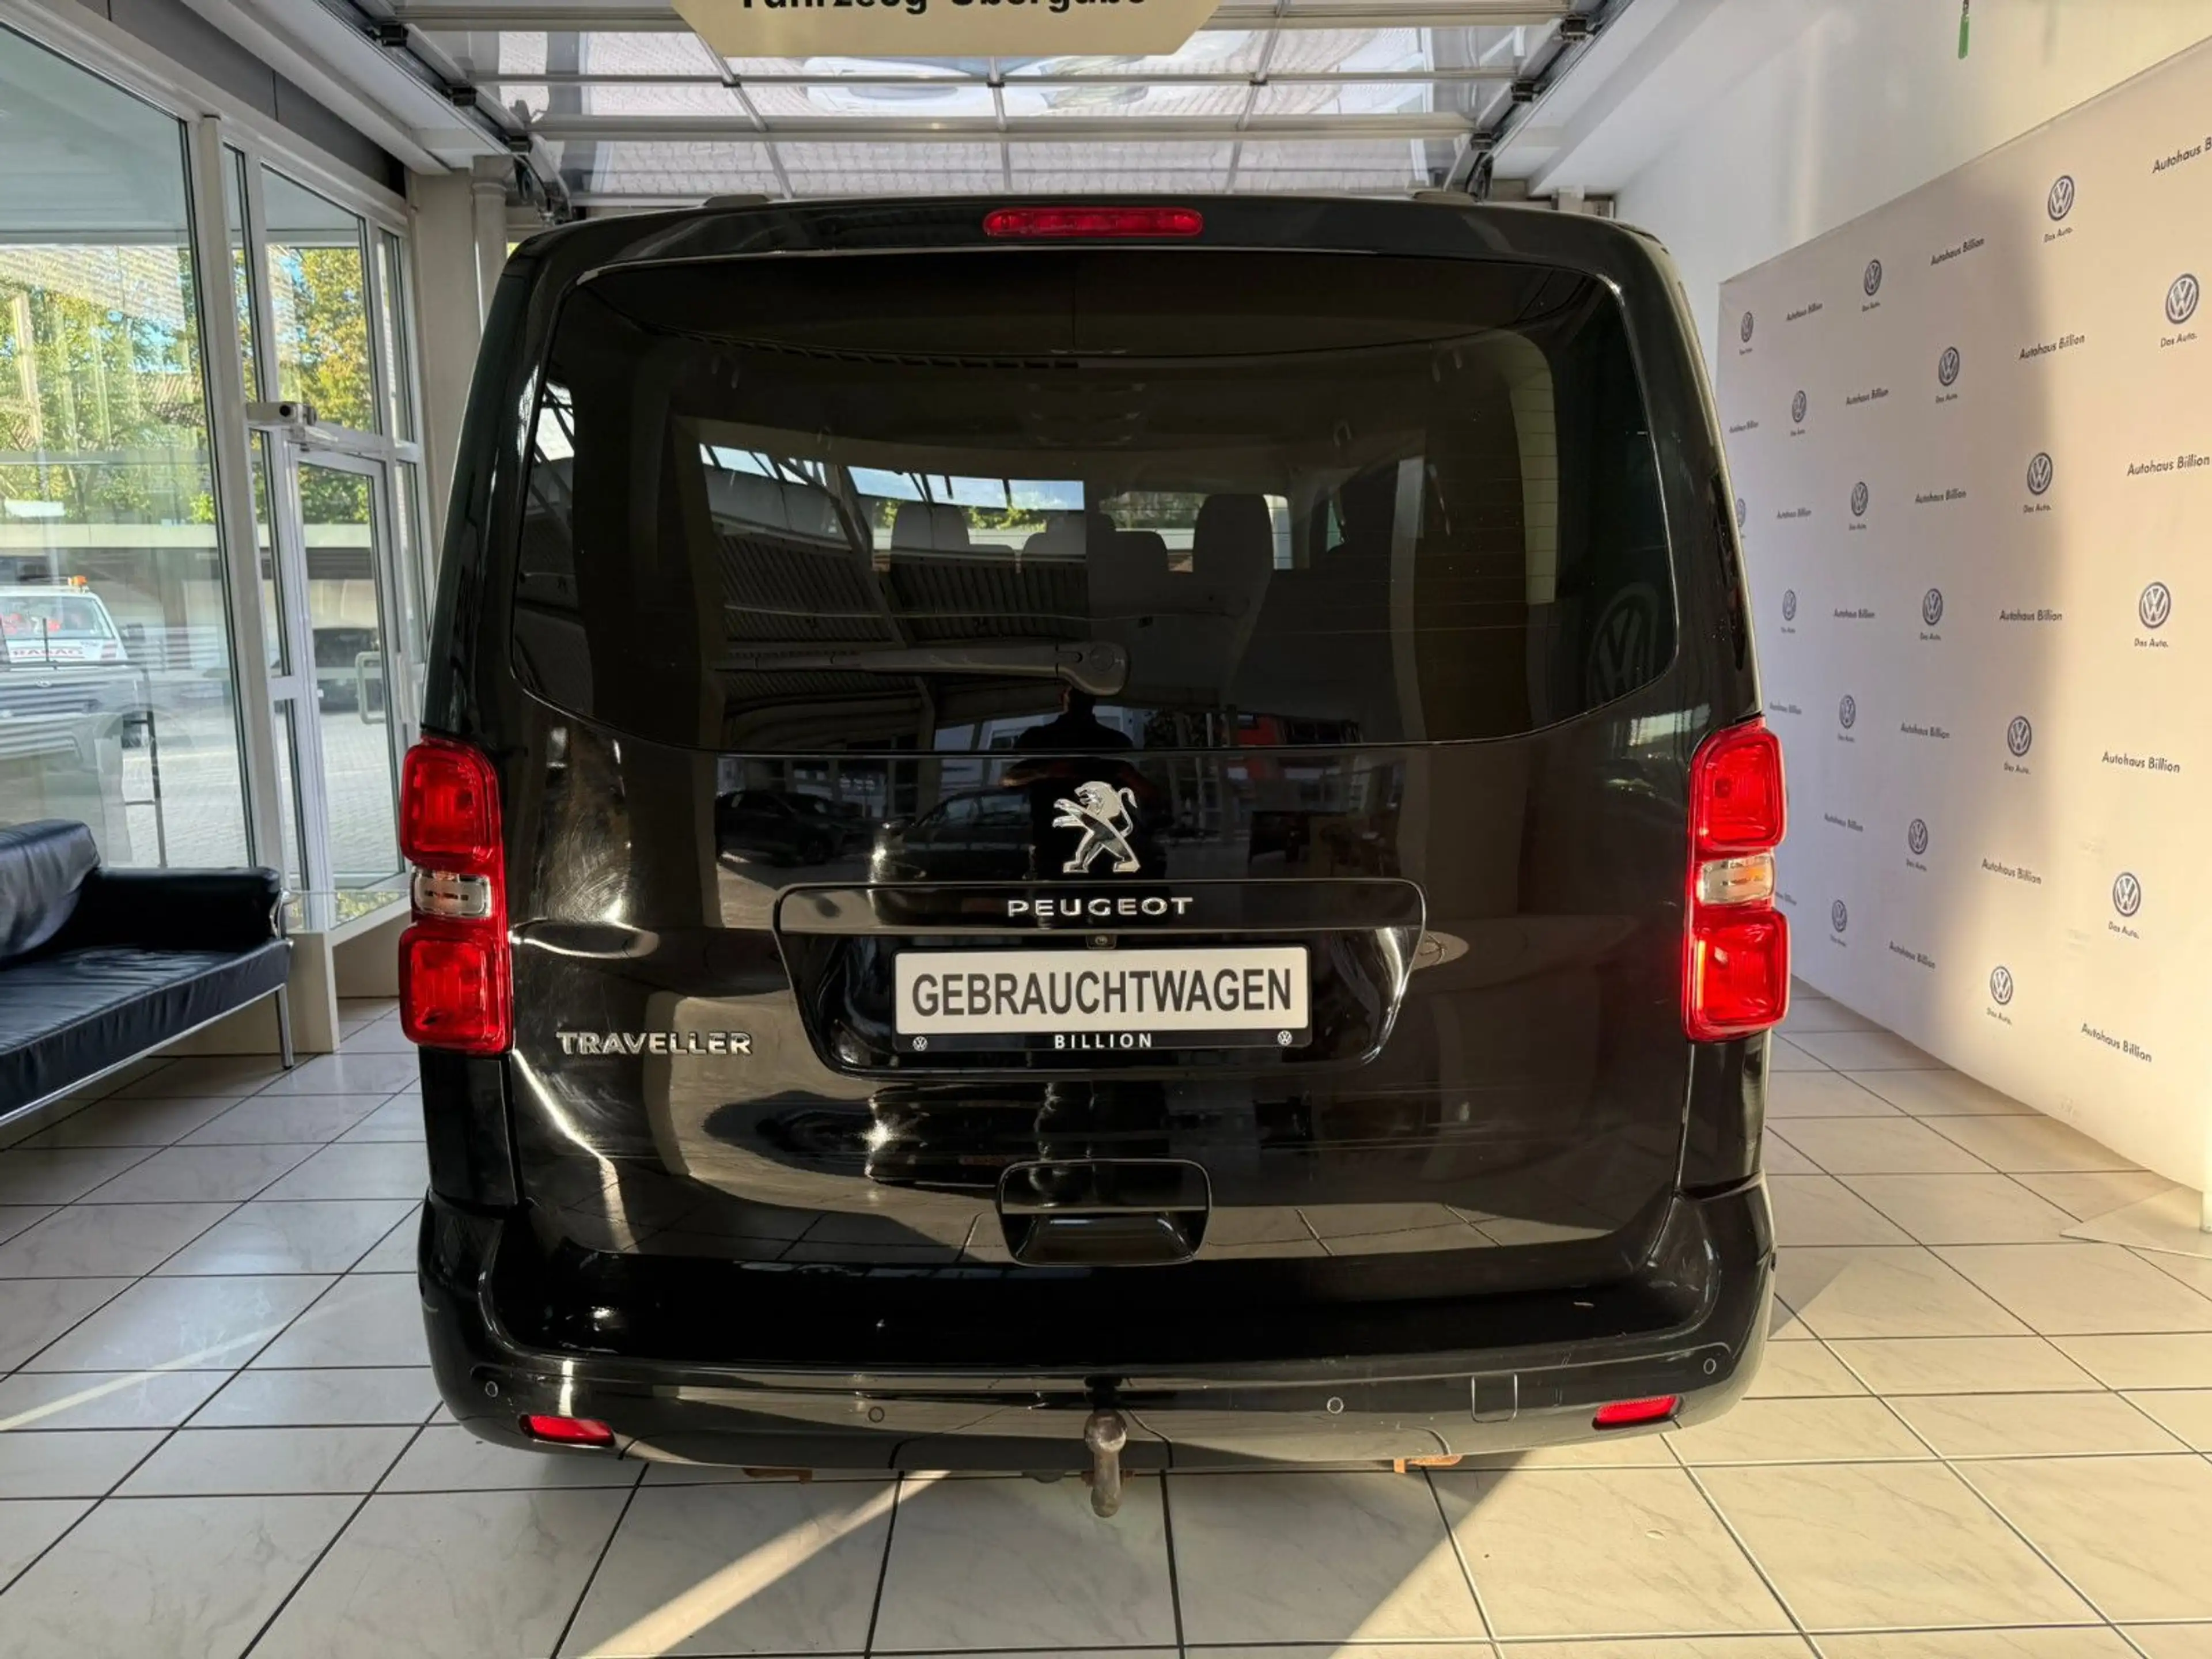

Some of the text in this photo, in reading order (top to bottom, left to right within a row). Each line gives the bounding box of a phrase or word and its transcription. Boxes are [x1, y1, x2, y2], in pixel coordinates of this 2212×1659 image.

[2152, 136, 2212, 175] Autohaus B
[2018, 334, 2085, 360] Autohaus Billion
[2160, 337, 2175, 348] Das
[2127, 453, 2210, 476] Autohaus Billion
[1999, 609, 2062, 622] Autohaus Billion
[2134, 638, 2147, 647] Das
[2101, 751, 2180, 773] Autohaus Billion
[1982, 858, 2042, 885] Autohaus Billion
[1007, 896, 1194, 917] PEUGEOT
[2108, 921, 2121, 933] Das
[912, 968, 1291, 1016] GEBRAUCHTWAGEN
[556, 1031, 752, 1055] TRAVELLER
[1054, 1032, 1152, 1049] BILLION
[2081, 1022, 2152, 1063] Autohaus Billion
